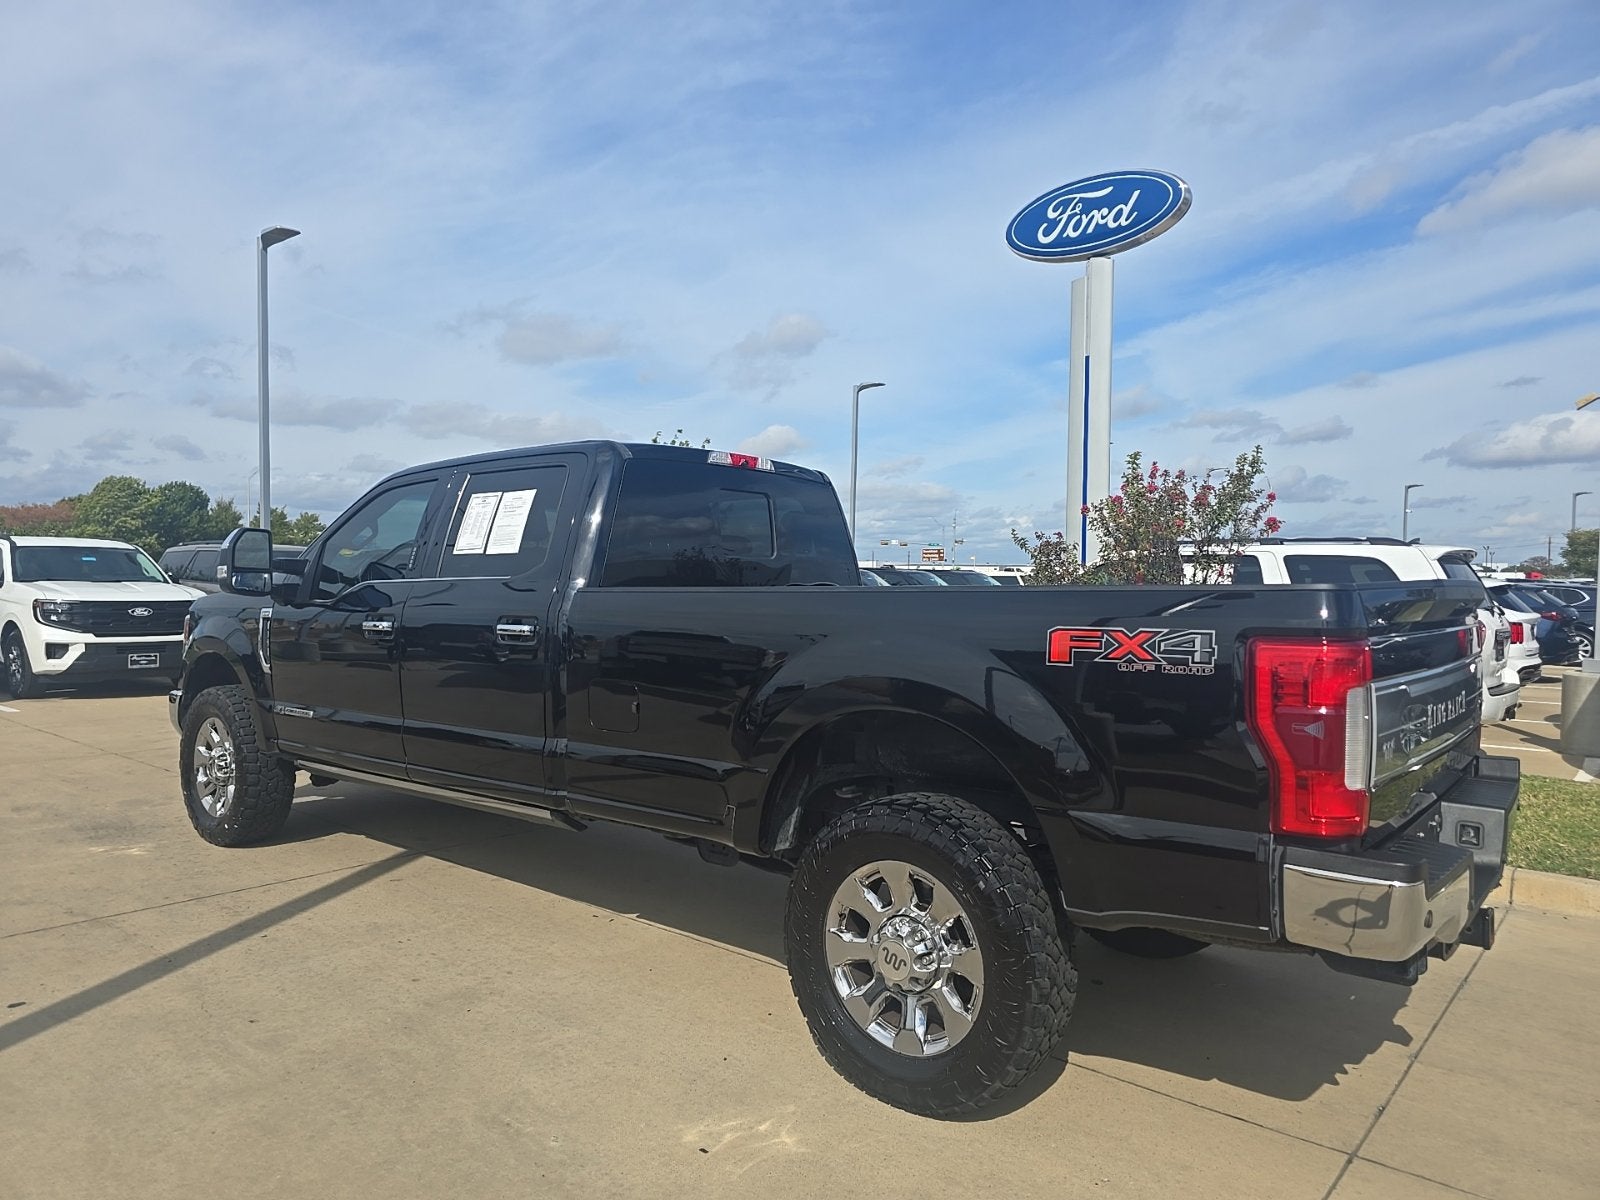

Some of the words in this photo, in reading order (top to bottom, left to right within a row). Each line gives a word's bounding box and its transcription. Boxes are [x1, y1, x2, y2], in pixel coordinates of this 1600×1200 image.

[1037, 185, 1141, 244] Ford
[1046, 626, 1218, 667] FX4
[1117, 662, 1156, 672] OFF
[1161, 664, 1215, 676] ROAD
[1427, 702, 1447, 730] KING
